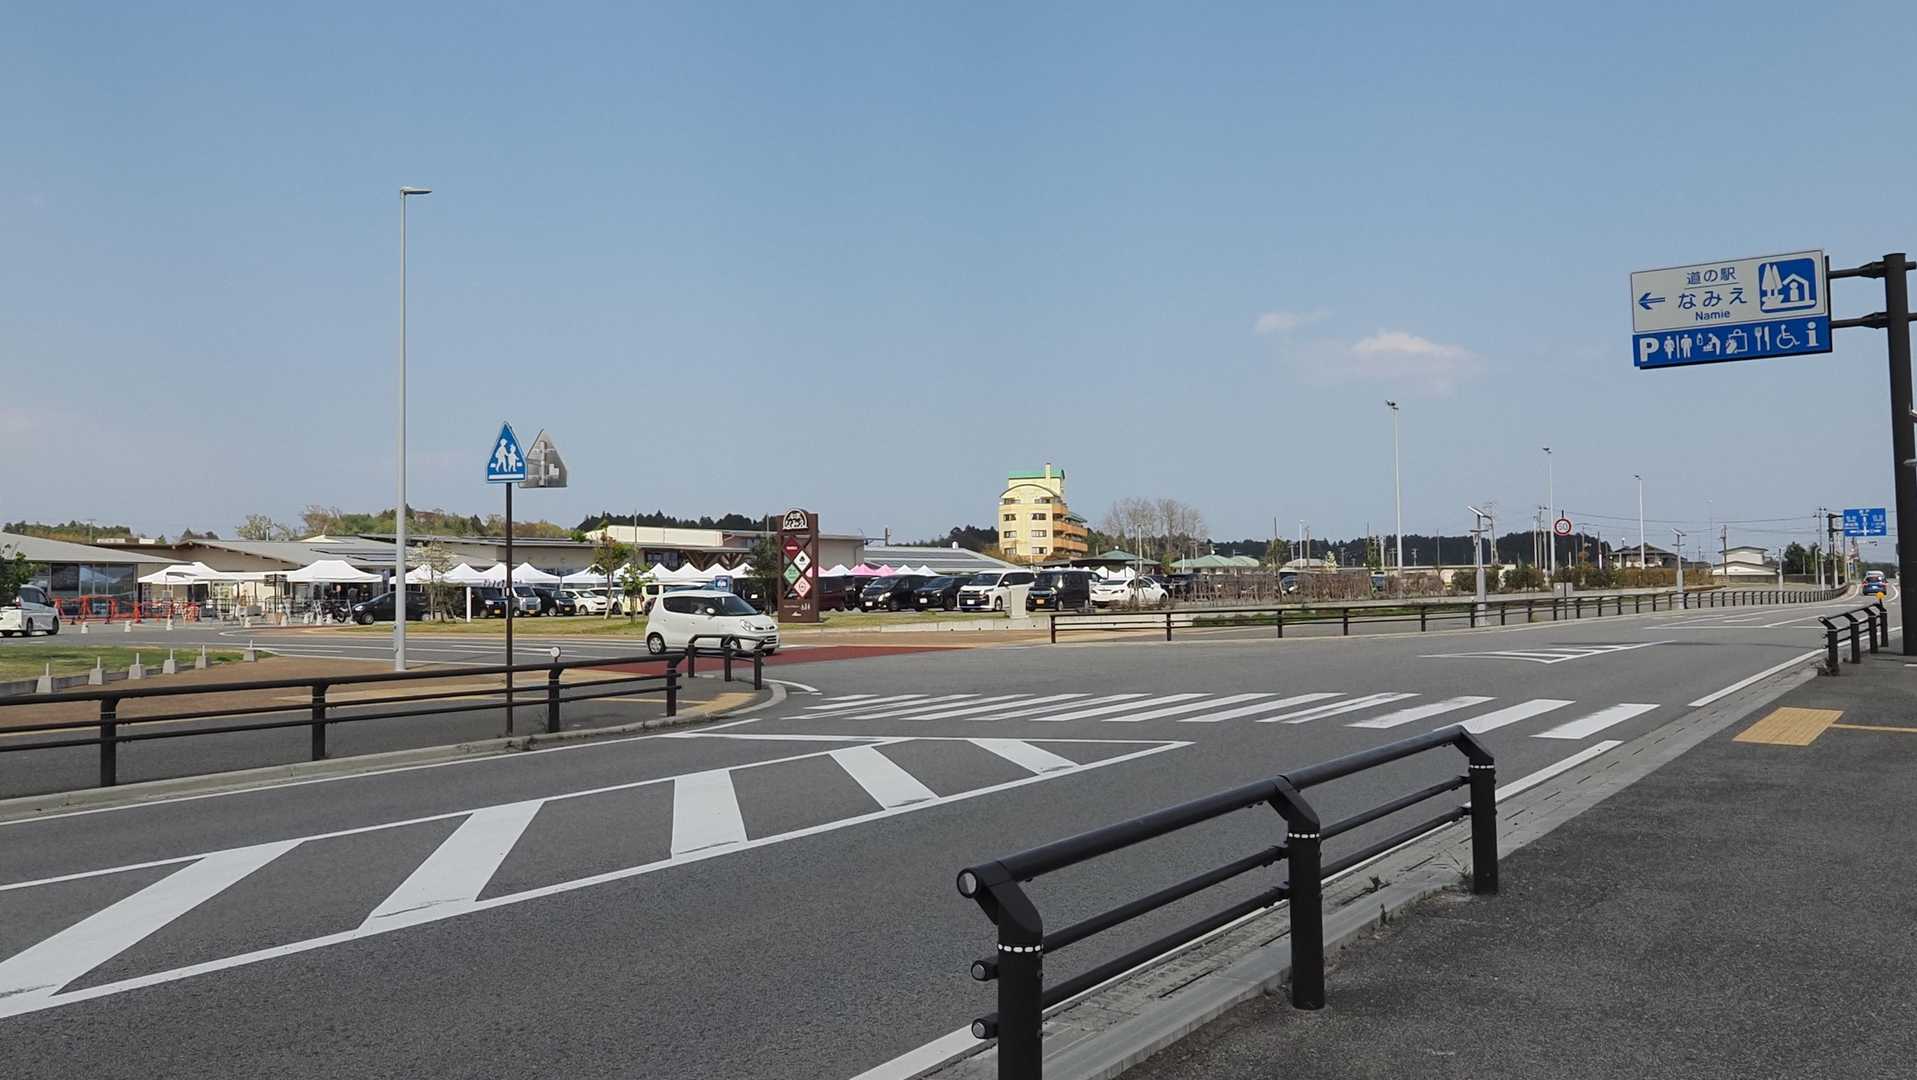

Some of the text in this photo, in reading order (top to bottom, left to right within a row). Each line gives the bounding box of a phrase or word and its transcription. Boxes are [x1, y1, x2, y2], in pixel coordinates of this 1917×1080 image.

[1686, 267, 1736, 285] 道の駅
[1678, 287, 1748, 309] なみえ
[1695, 309, 1731, 321] Namie
[1639, 337, 1660, 362] P
